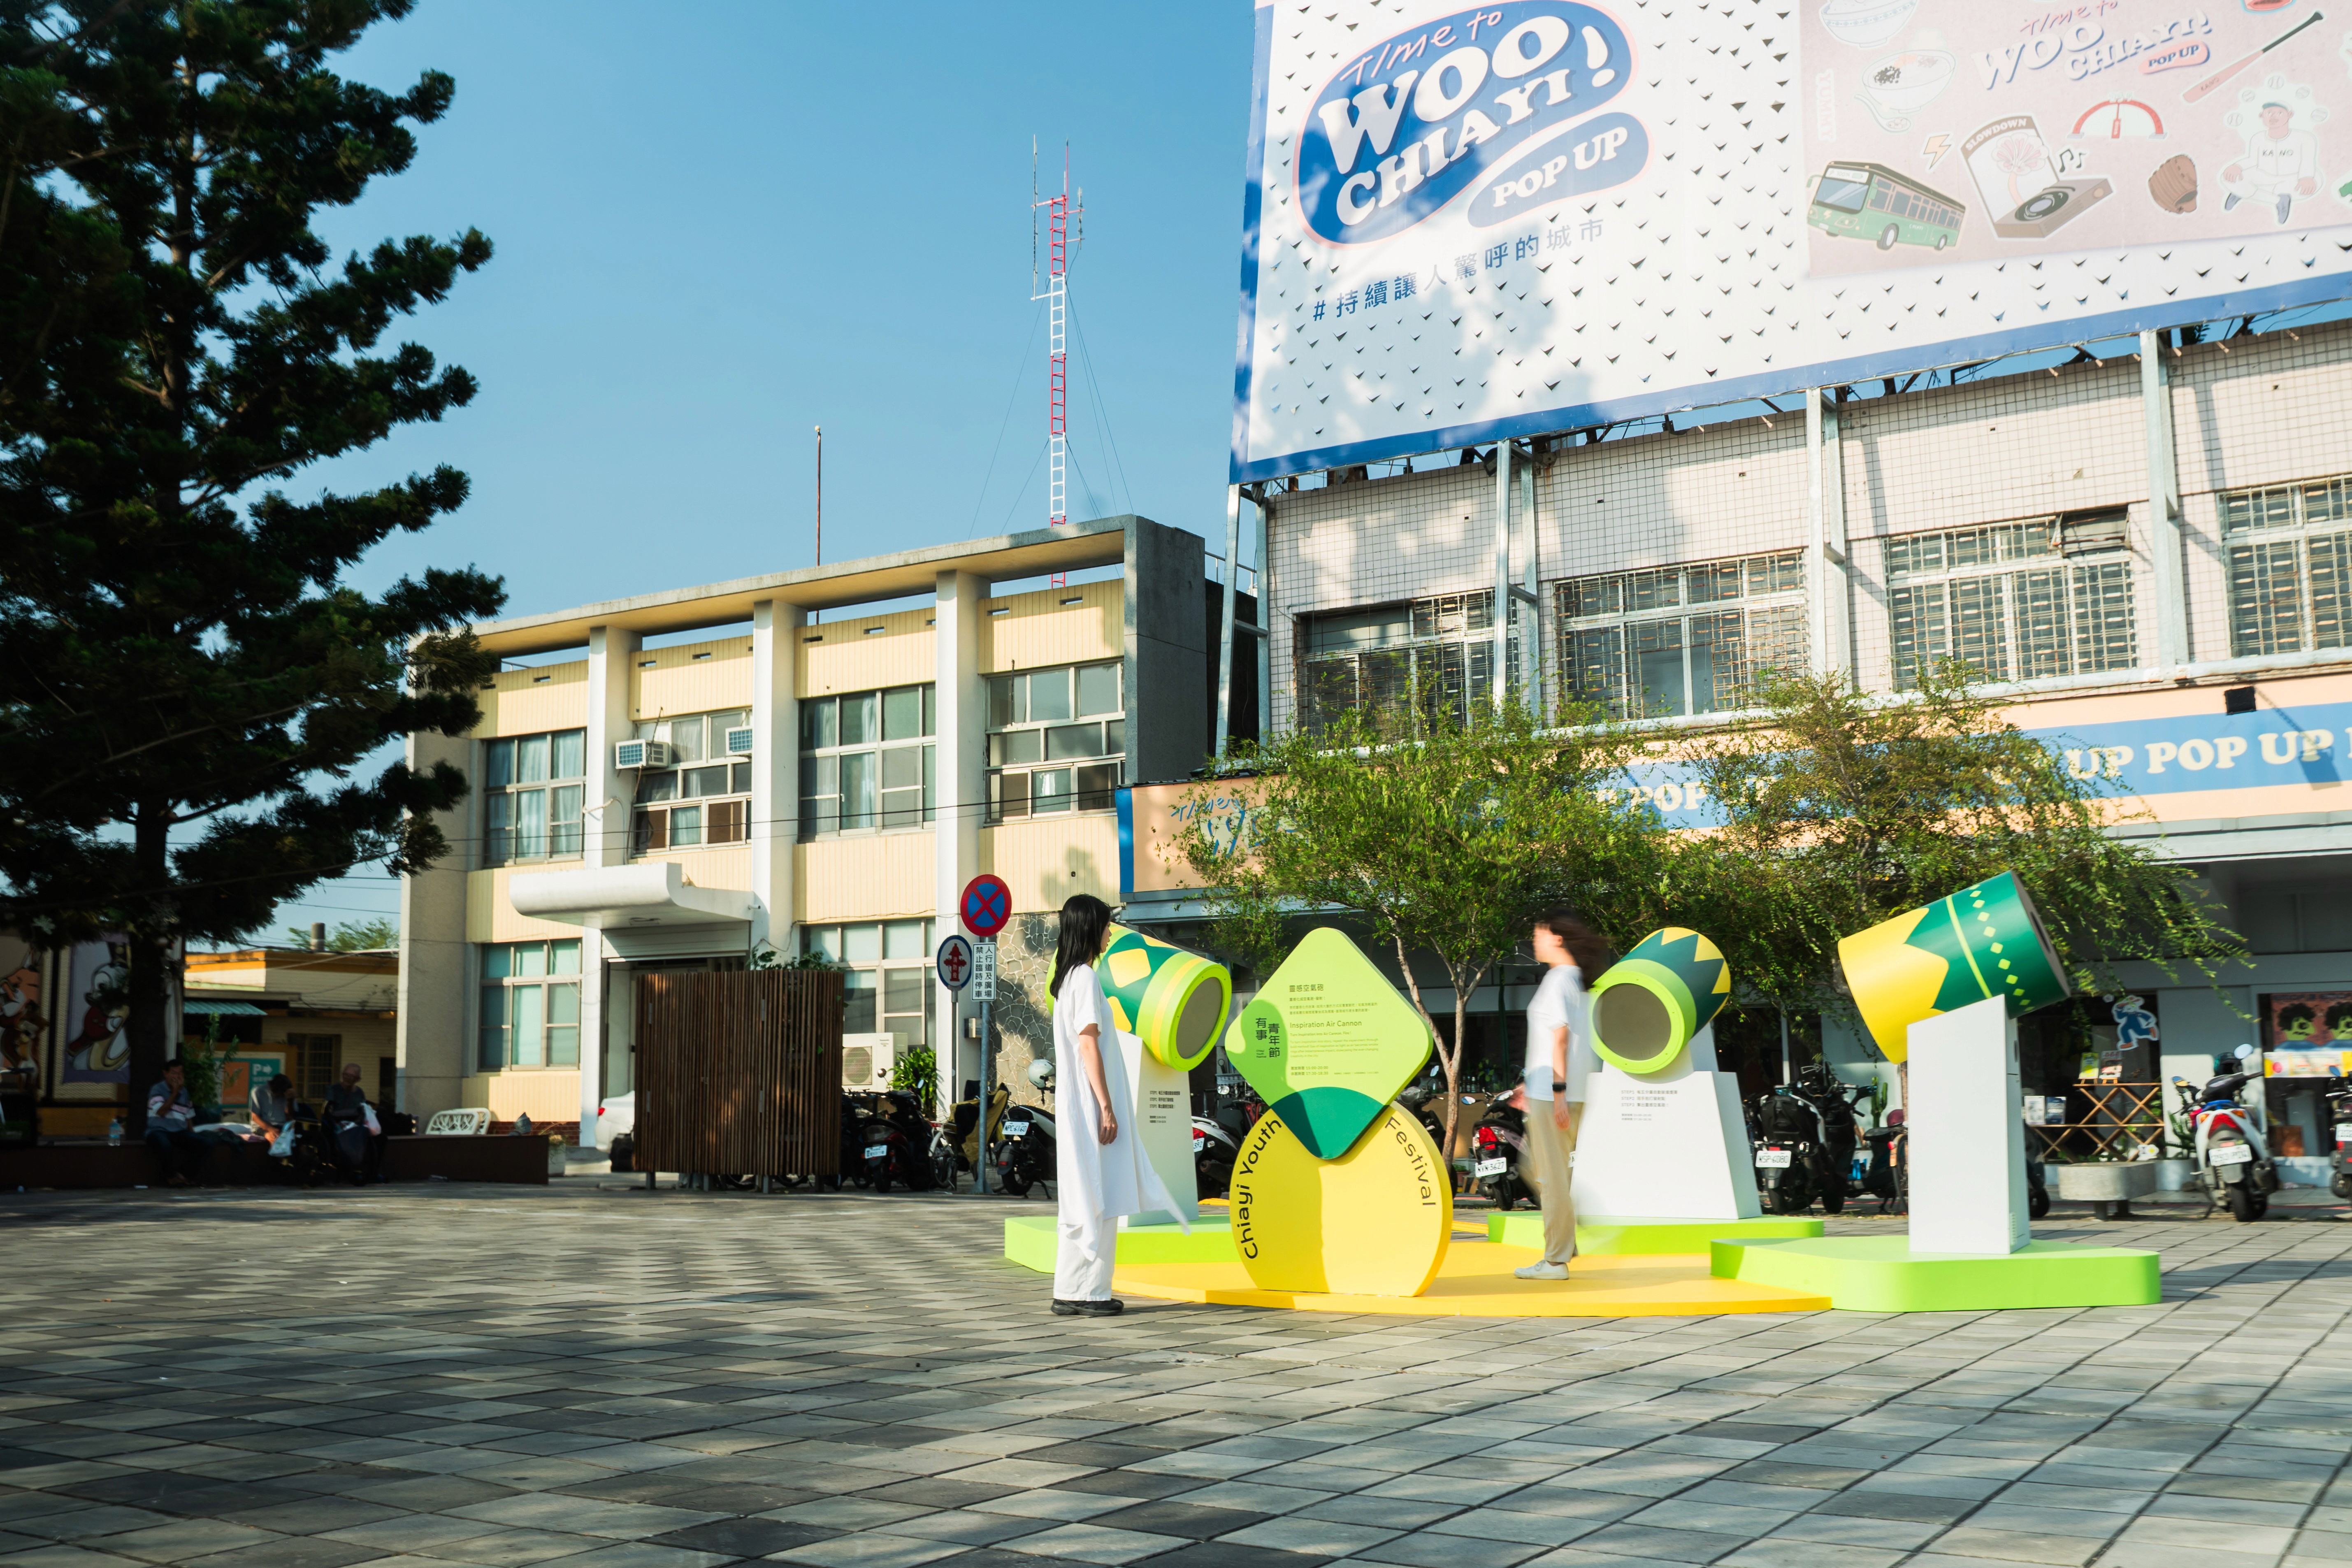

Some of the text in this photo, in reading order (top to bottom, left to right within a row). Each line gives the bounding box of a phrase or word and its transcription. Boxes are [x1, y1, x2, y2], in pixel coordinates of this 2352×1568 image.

[1465, 10, 1502, 41] to
[1971, 21, 2104, 90] WOO
[2148, 44, 2199, 67] POP UP
[1318, 16, 1570, 175] WOO
[1819, 72, 1834, 141] YUMMY
[1965, 117, 2027, 151] SLOWDOWN
[1492, 127, 1628, 208] POP UP
[2064, 745, 2134, 779] UP
[2144, 736, 2248, 774] POP
[2258, 729, 2334, 765] UP
[975, 946, 984, 998] 禁止臨時停車
[984, 946, 993, 998] 人行道及廣場
[1256, 1017, 1267, 1040] 有事
[1268, 1023, 1280, 1057] 青年節
[1237, 1117, 1437, 1259] Chiayi Youth Festival
